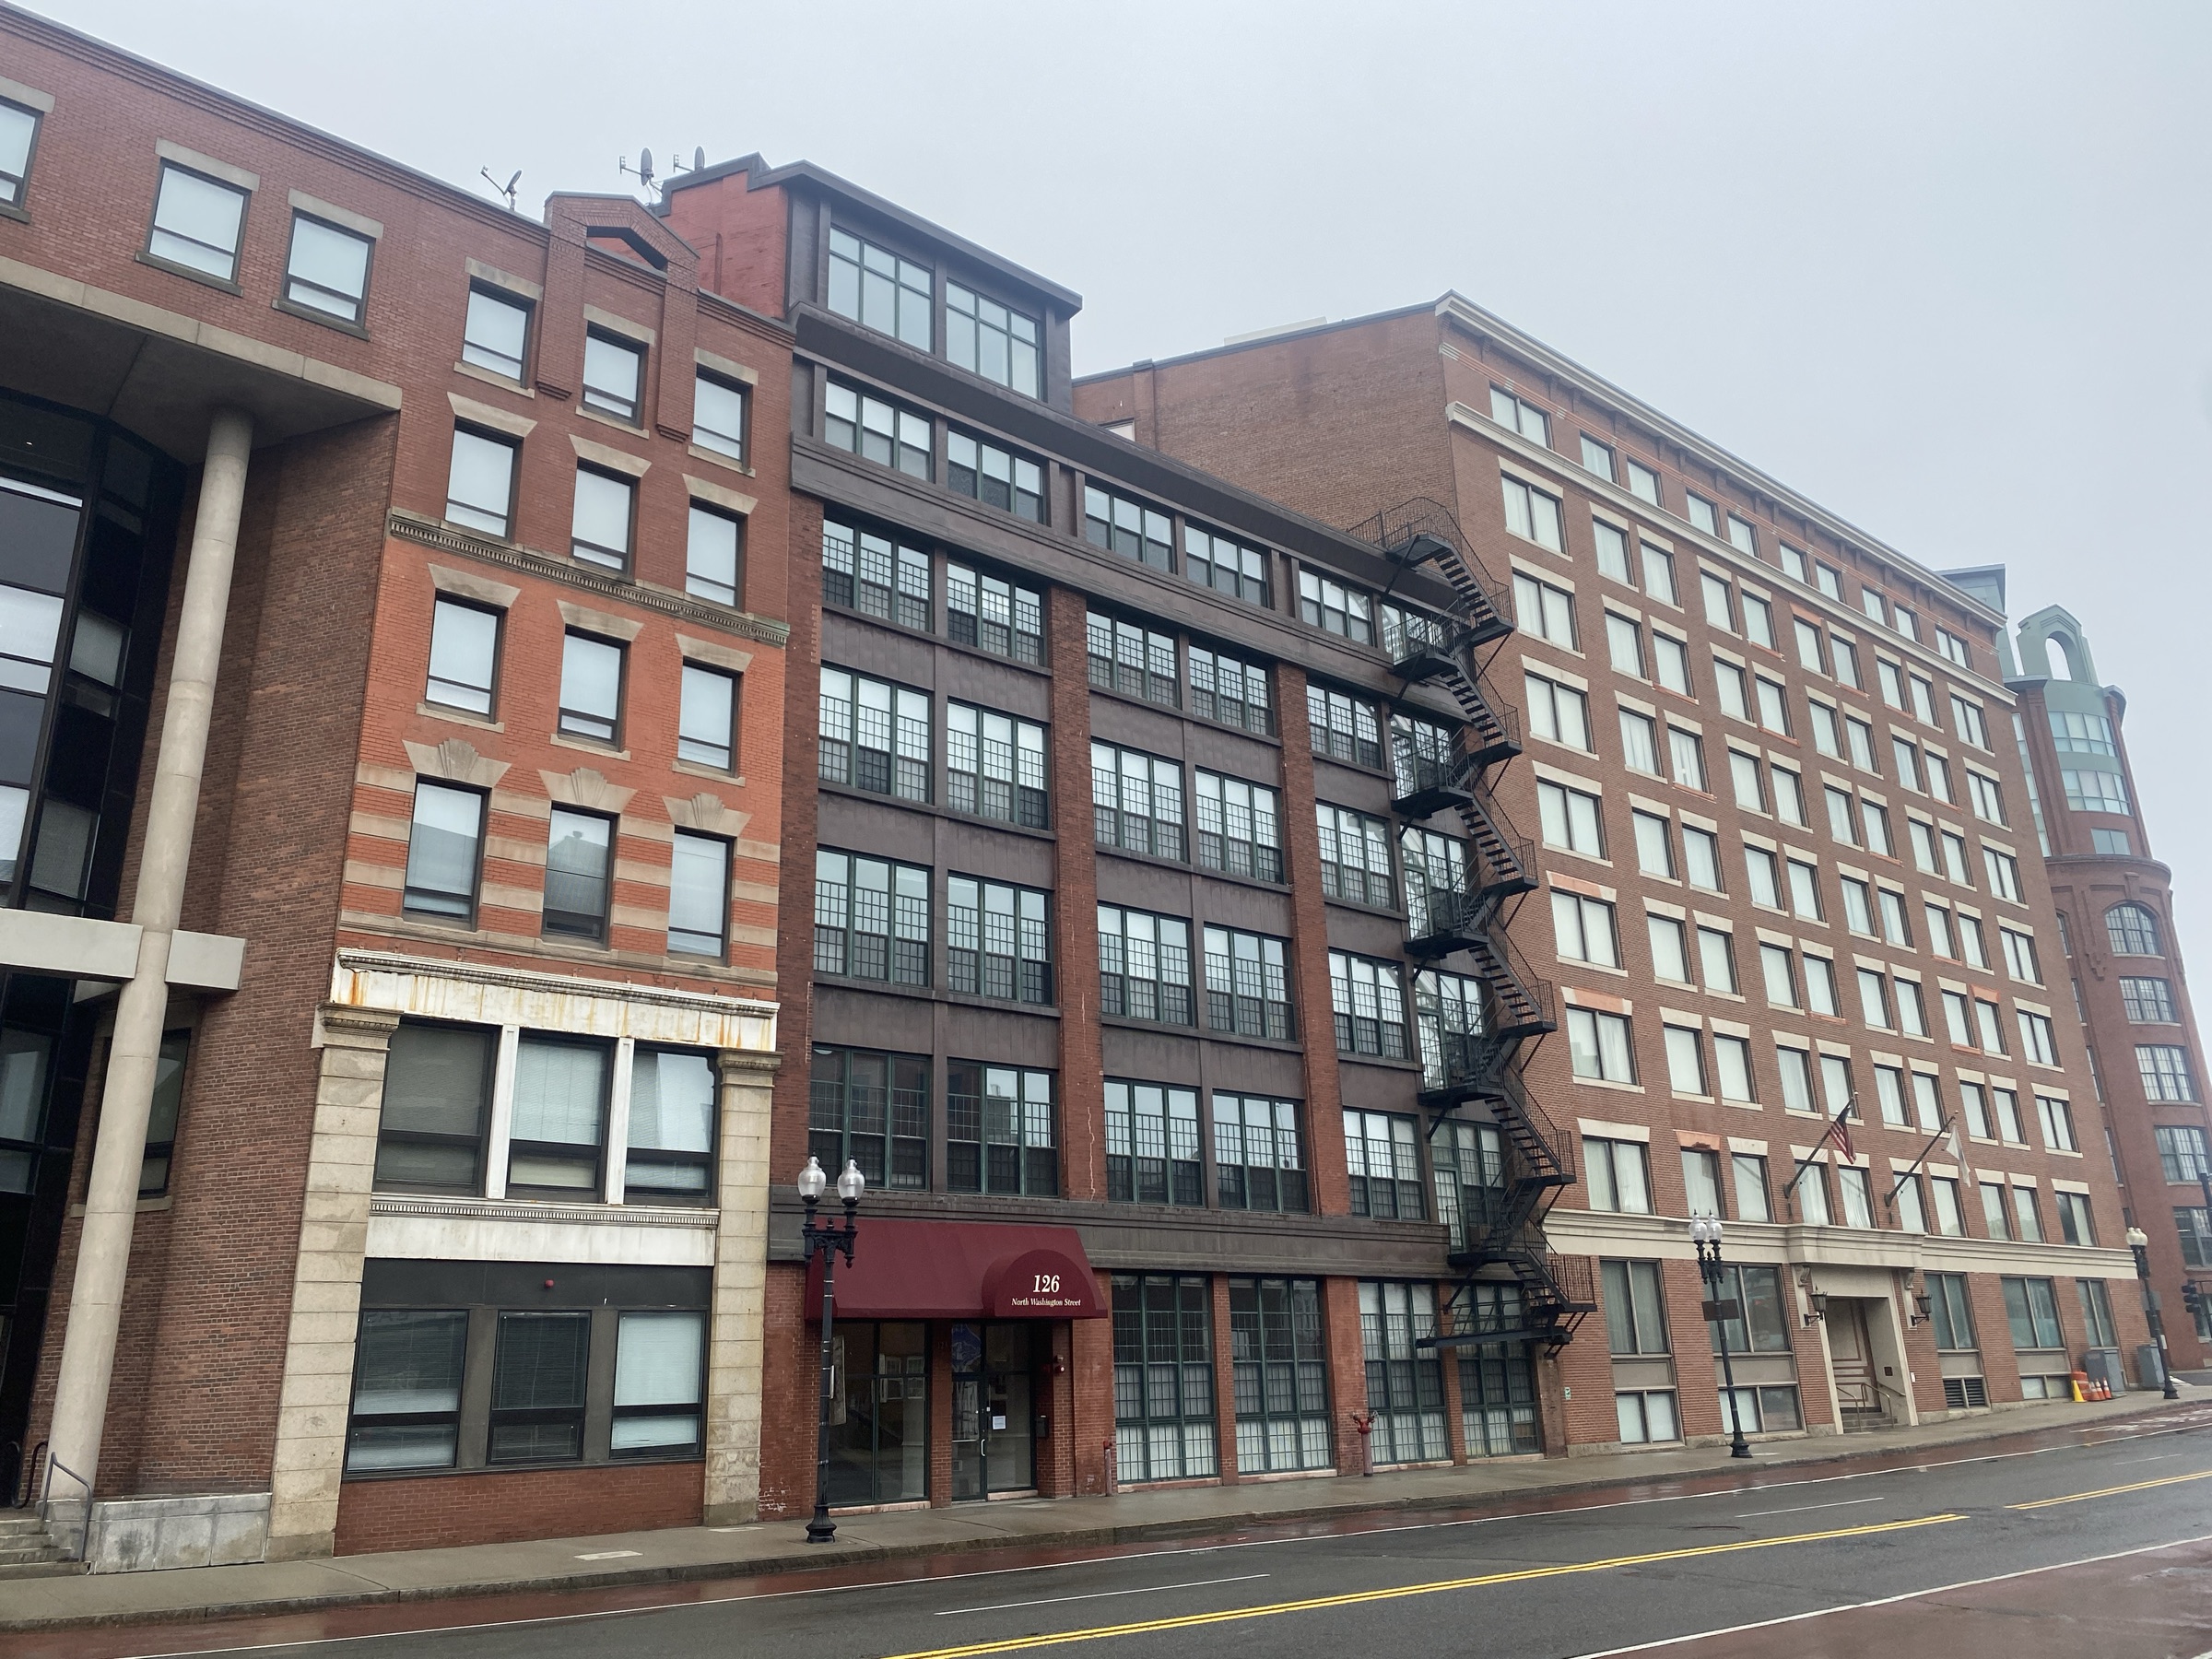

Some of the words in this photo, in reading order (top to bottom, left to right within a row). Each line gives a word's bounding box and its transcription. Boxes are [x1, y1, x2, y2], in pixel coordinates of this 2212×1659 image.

[1033, 1275, 1060, 1292] 126
[1011, 1298, 1029, 1306] North
[1030, 1297, 1063, 1307] Washington
[1064, 1298, 1081, 1306] Street
